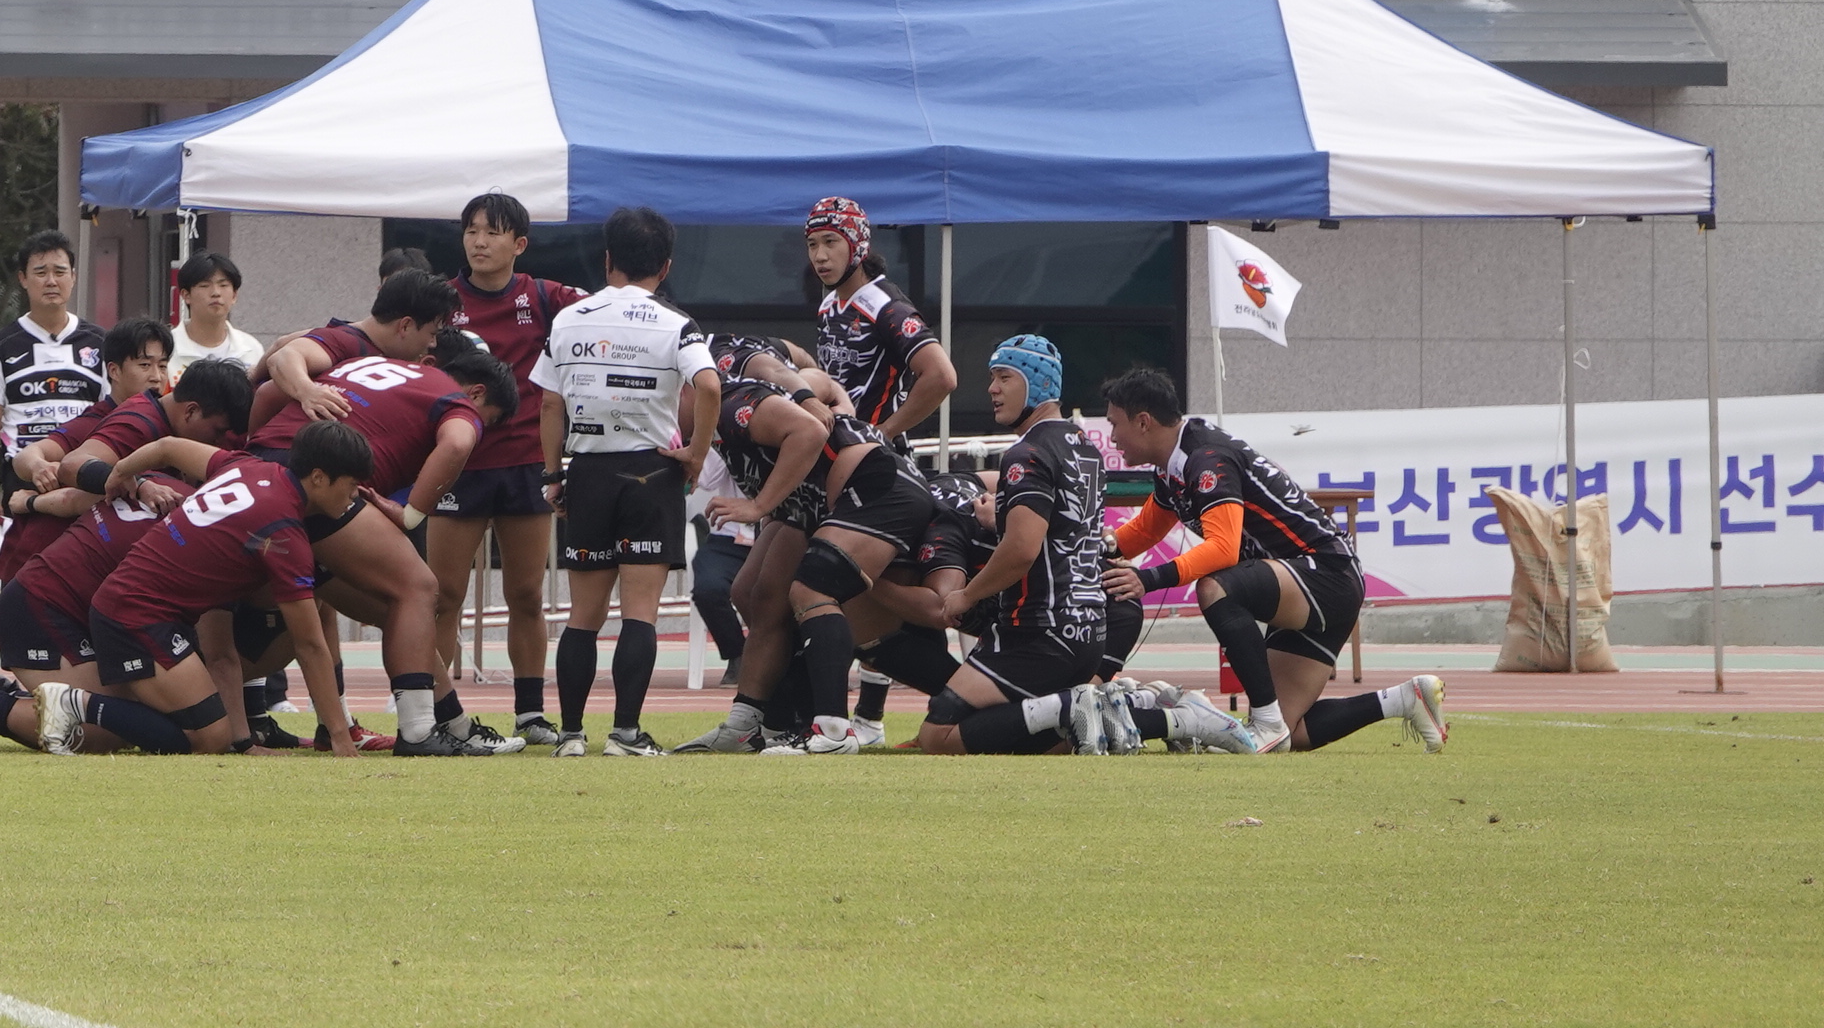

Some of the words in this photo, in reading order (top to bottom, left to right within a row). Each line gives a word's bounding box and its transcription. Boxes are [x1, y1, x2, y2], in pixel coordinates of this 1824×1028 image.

[623, 310, 658, 323] 액티브
[611, 343, 650, 354] FINANCIAL
[611, 351, 637, 360] GROUP
[328, 356, 424, 391] 16
[182, 467, 255, 528] 19
[629, 540, 663, 554] 캐피탈
